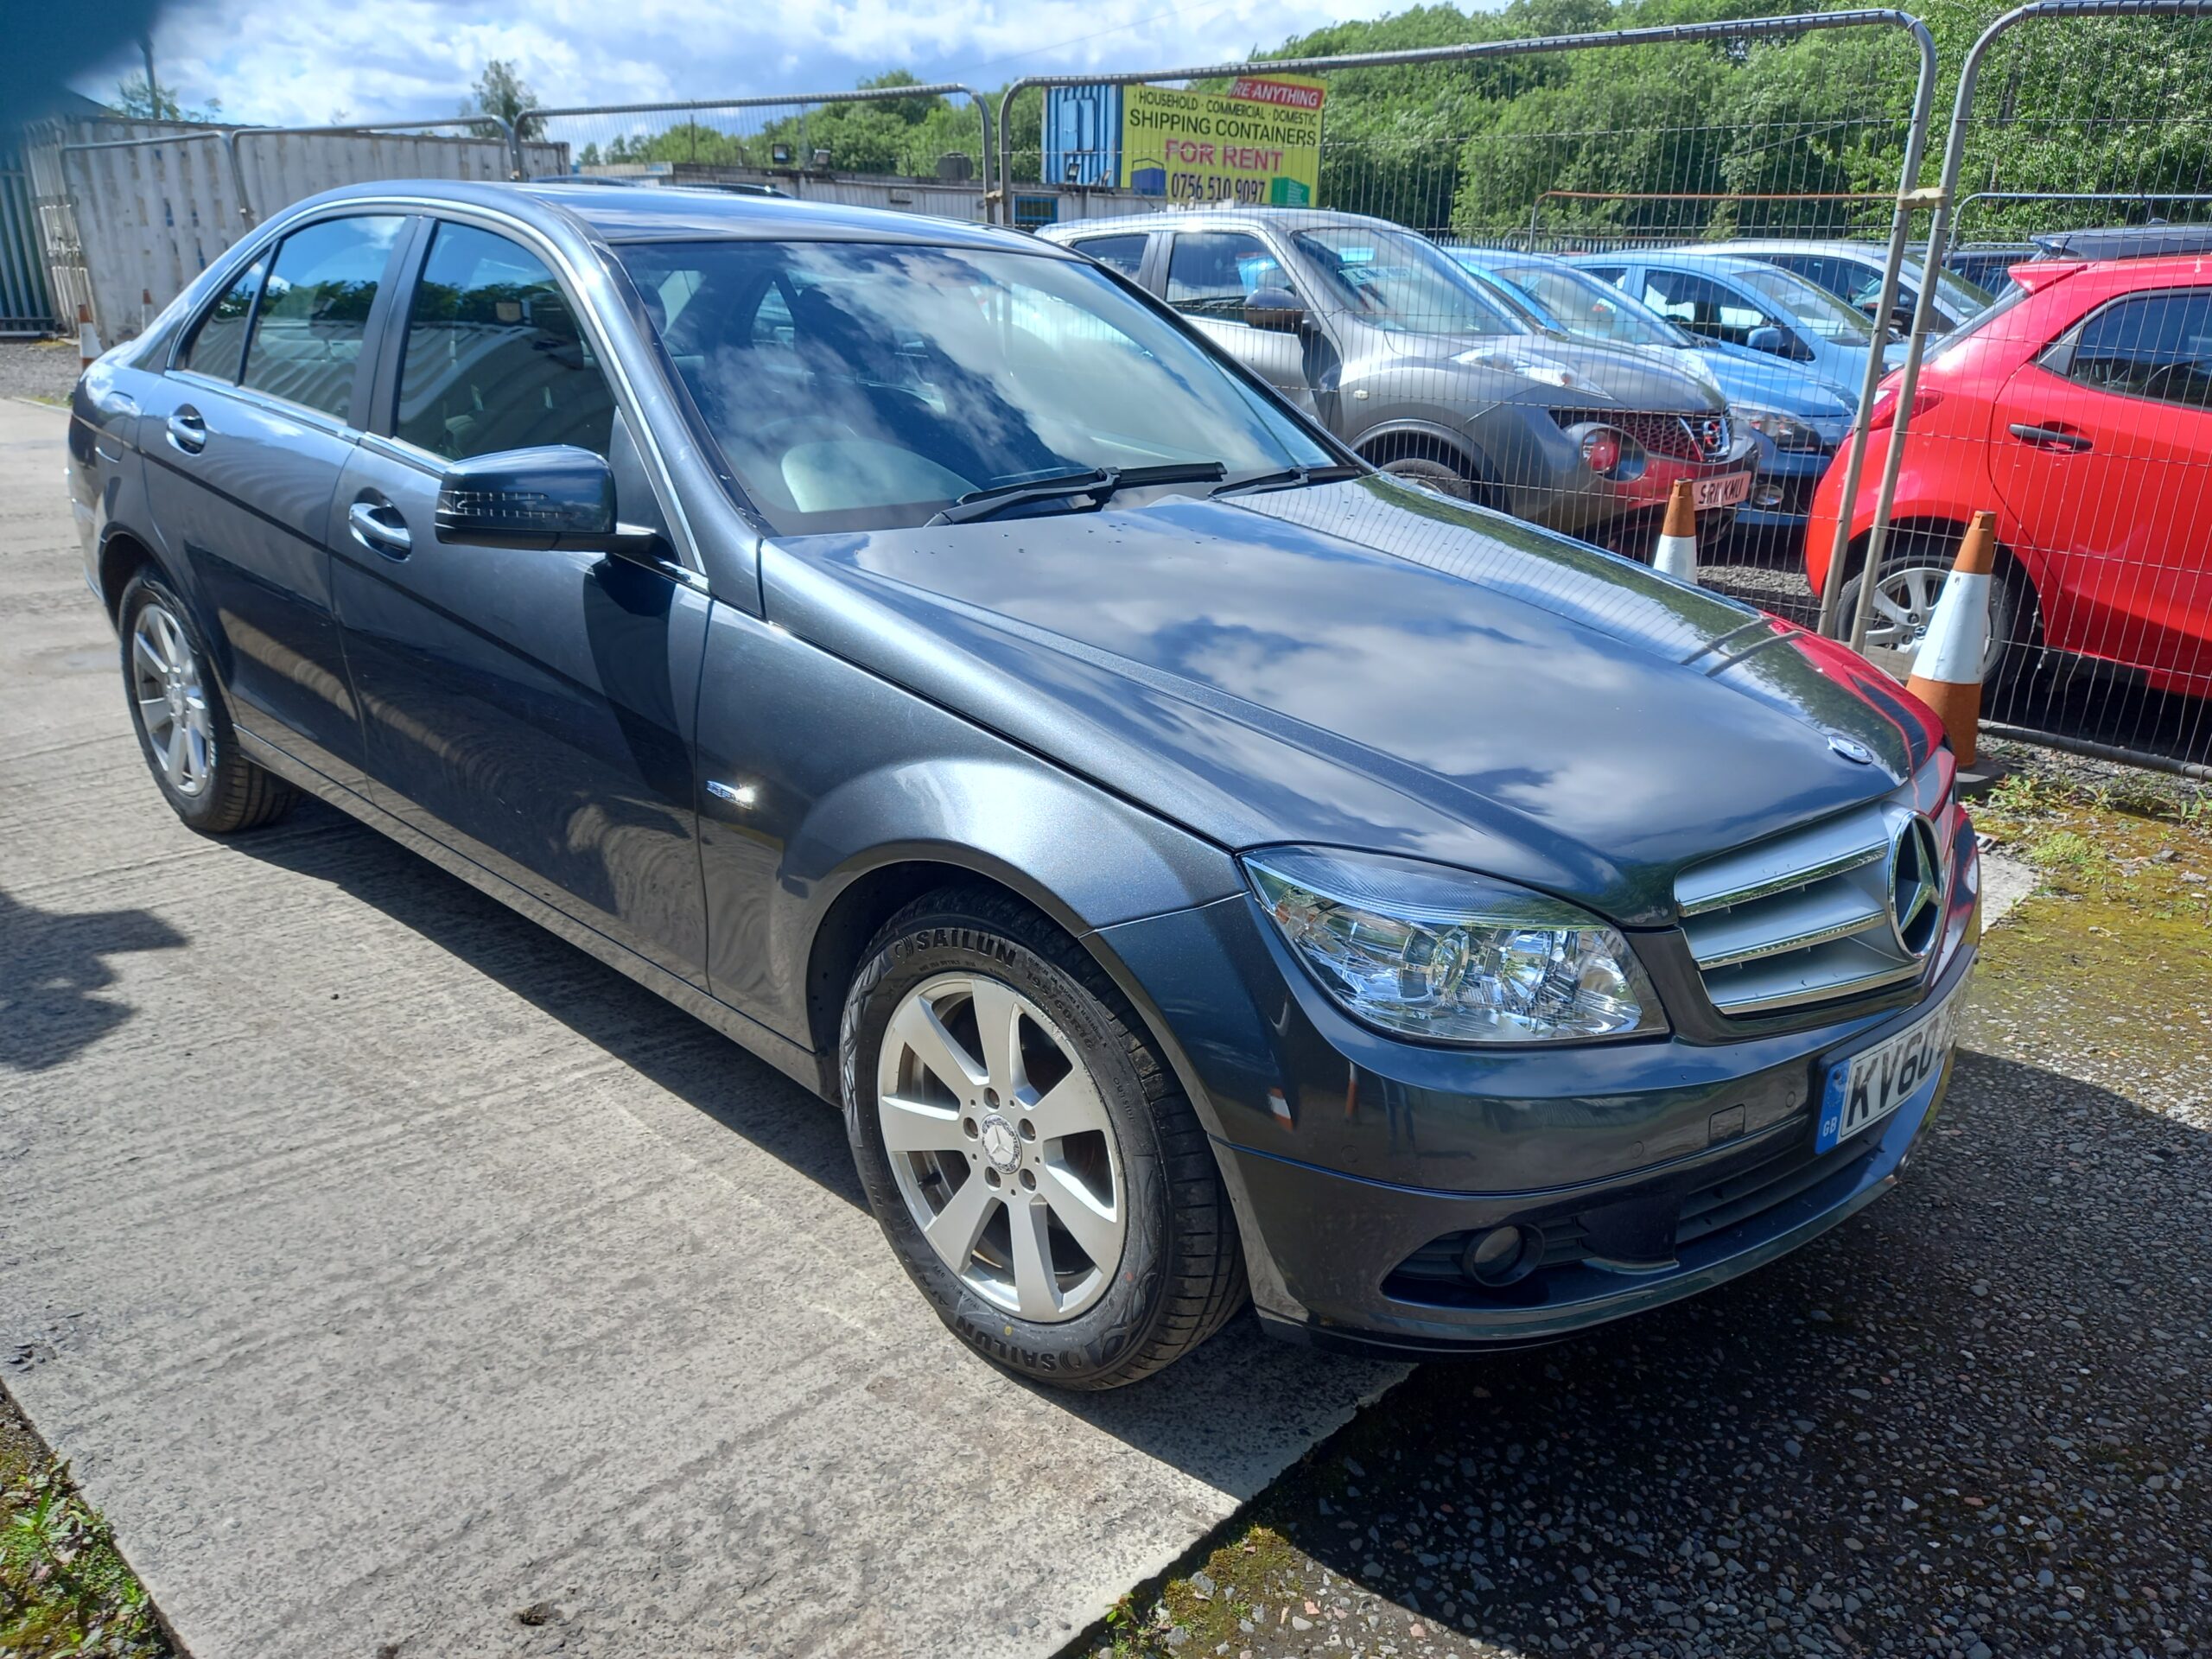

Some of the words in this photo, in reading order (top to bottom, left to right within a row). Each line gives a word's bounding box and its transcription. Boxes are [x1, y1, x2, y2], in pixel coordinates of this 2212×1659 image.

[1139, 93, 1198, 111] HOUSEHOLD
[1205, 99, 1265, 121] COMMERCIAL
[1273, 108, 1317, 126] DOMESTIC
[1252, 84, 1319, 107] ANYTHING
[1129, 109, 1211, 135] SHIPPING
[1216, 121, 1317, 147] CONTAINERS
[1166, 139, 1215, 166] FOR
[1223, 149, 1284, 172] RENT
[1171, 173, 1204, 201] 0756
[1207, 175, 1231, 201] 510
[1235, 178, 1266, 204] 9097
[916, 928, 1016, 969] SAILUN
[1822, 1116, 1838, 1137] GB
[955, 1315, 1058, 1372] SAILUN
